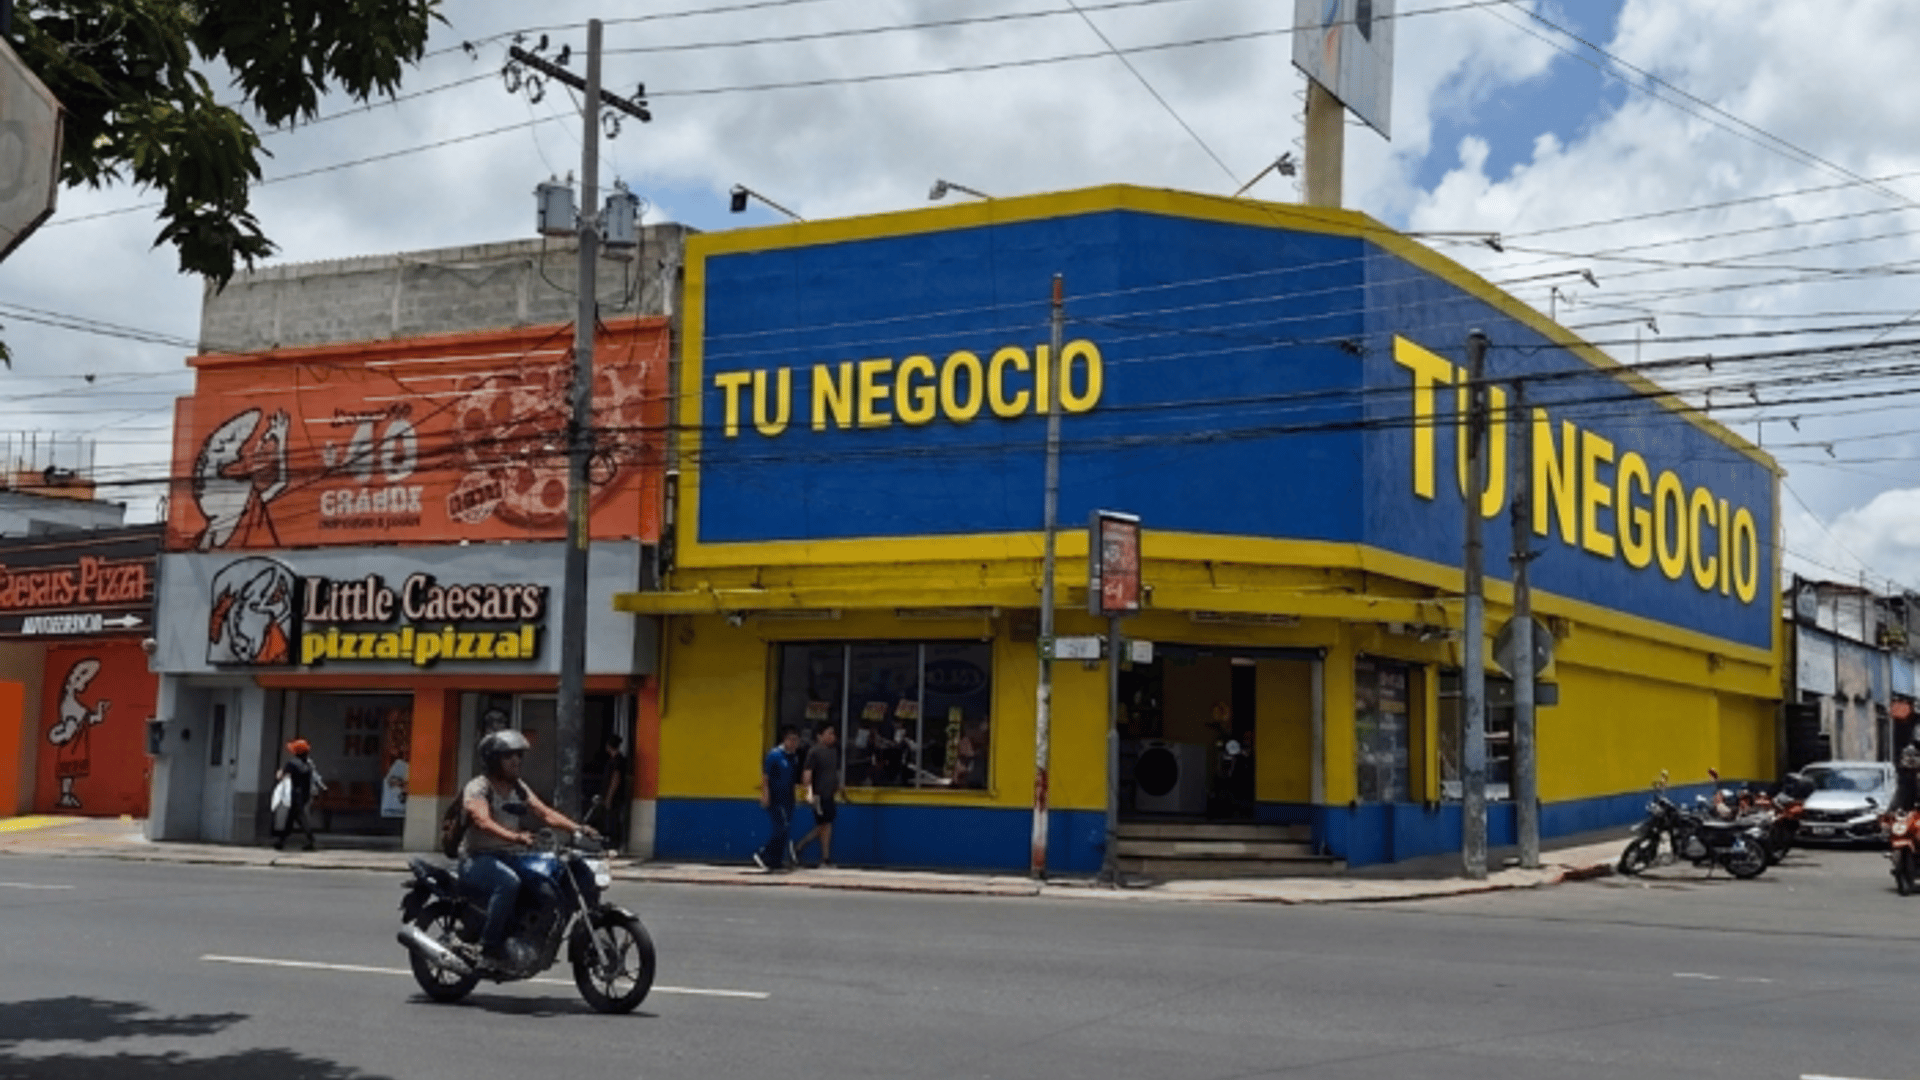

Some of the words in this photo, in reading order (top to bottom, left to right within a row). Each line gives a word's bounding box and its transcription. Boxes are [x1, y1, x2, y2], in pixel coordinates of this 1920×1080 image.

[714, 367, 791, 437] TU
[811, 339, 1102, 430] NEGOCIO
[1393, 334, 1506, 518] TU
[1533, 407, 1759, 605] NEGOCIO
[303, 575, 394, 621] Little
[403, 574, 540, 618] Caesars
